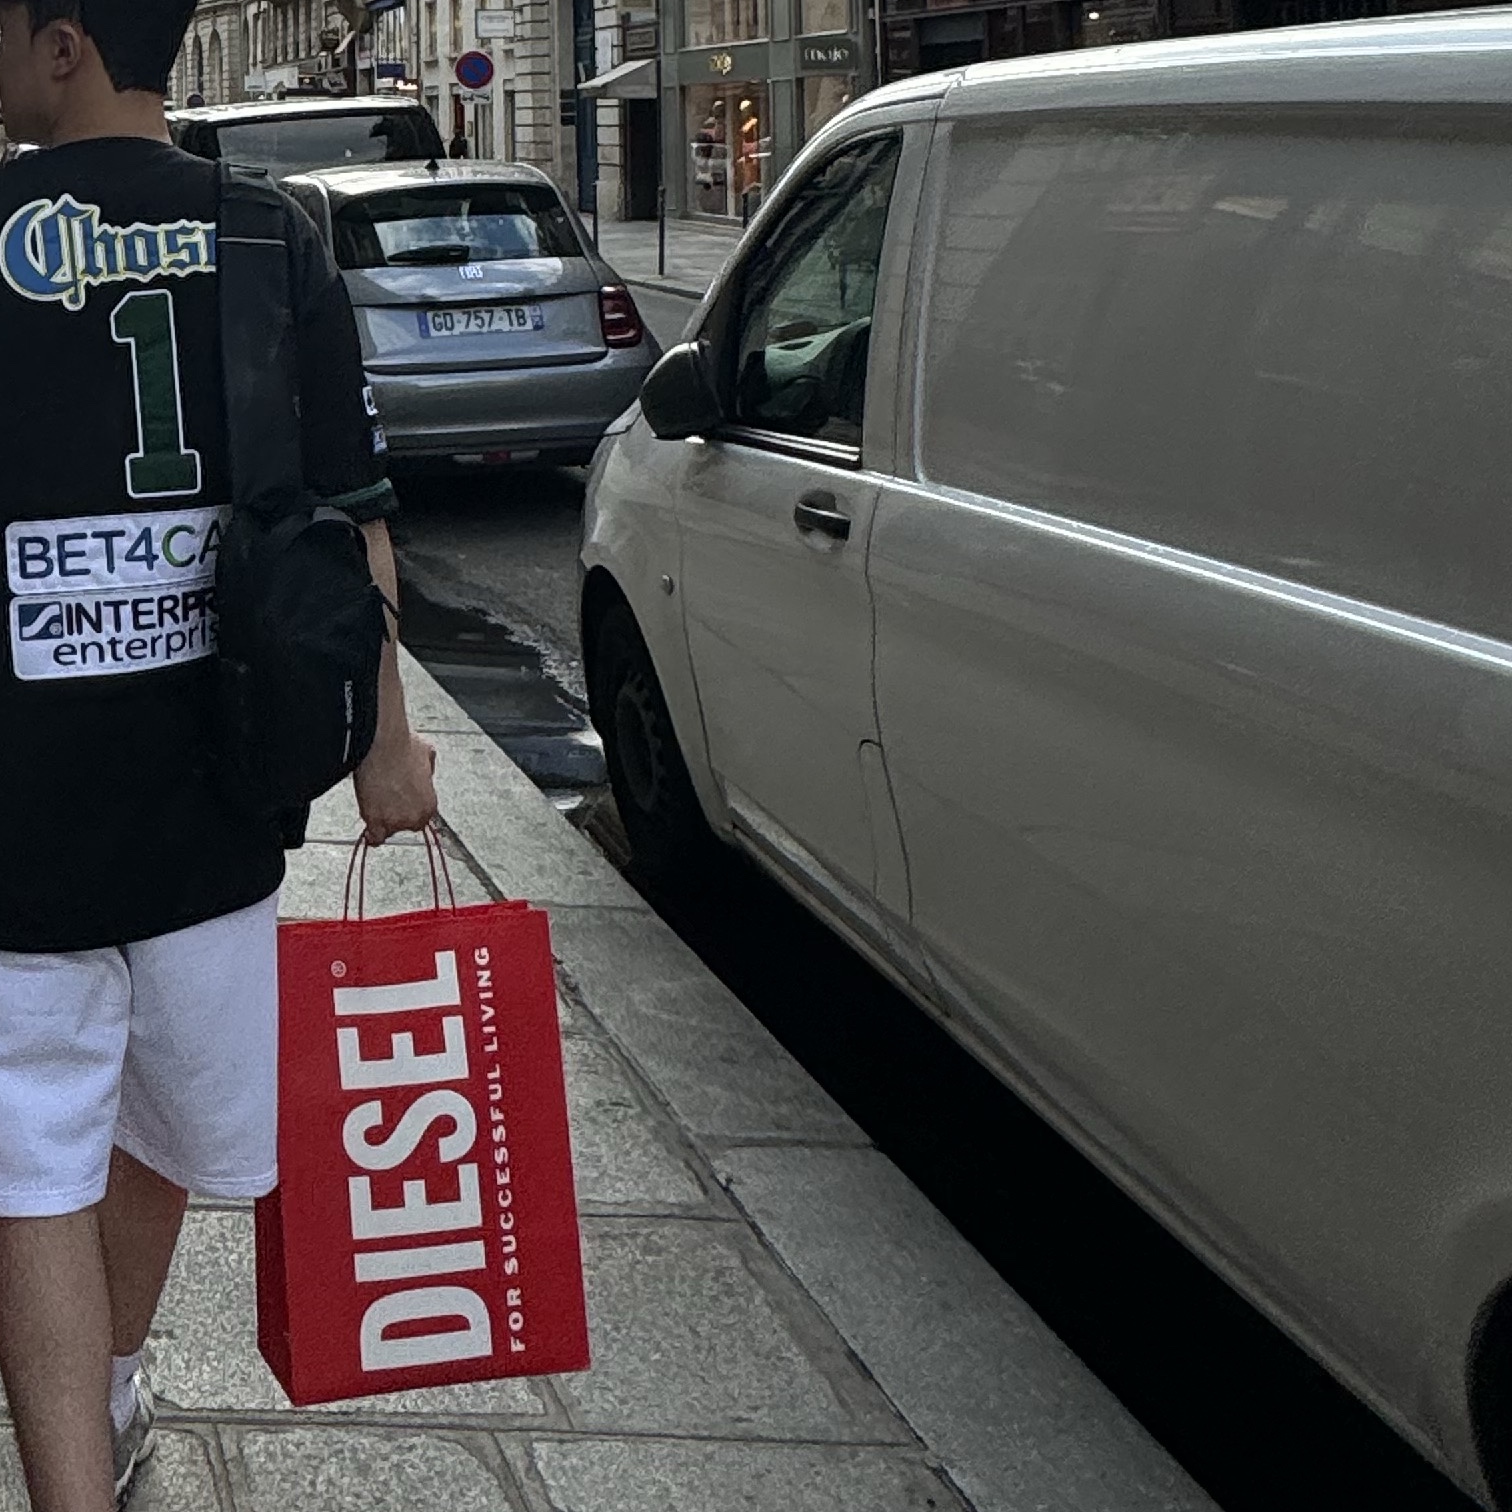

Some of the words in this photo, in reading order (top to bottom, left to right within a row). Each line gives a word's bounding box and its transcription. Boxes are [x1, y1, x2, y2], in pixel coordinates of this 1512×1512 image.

[109, 289, 201, 499] 1
[474, 947, 498, 1052] LIVING
[333, 950, 493, 1372] DIESEL
[487, 1064, 519, 1275] SUCCESSFUL
[506, 1287, 526, 1352] FOR
